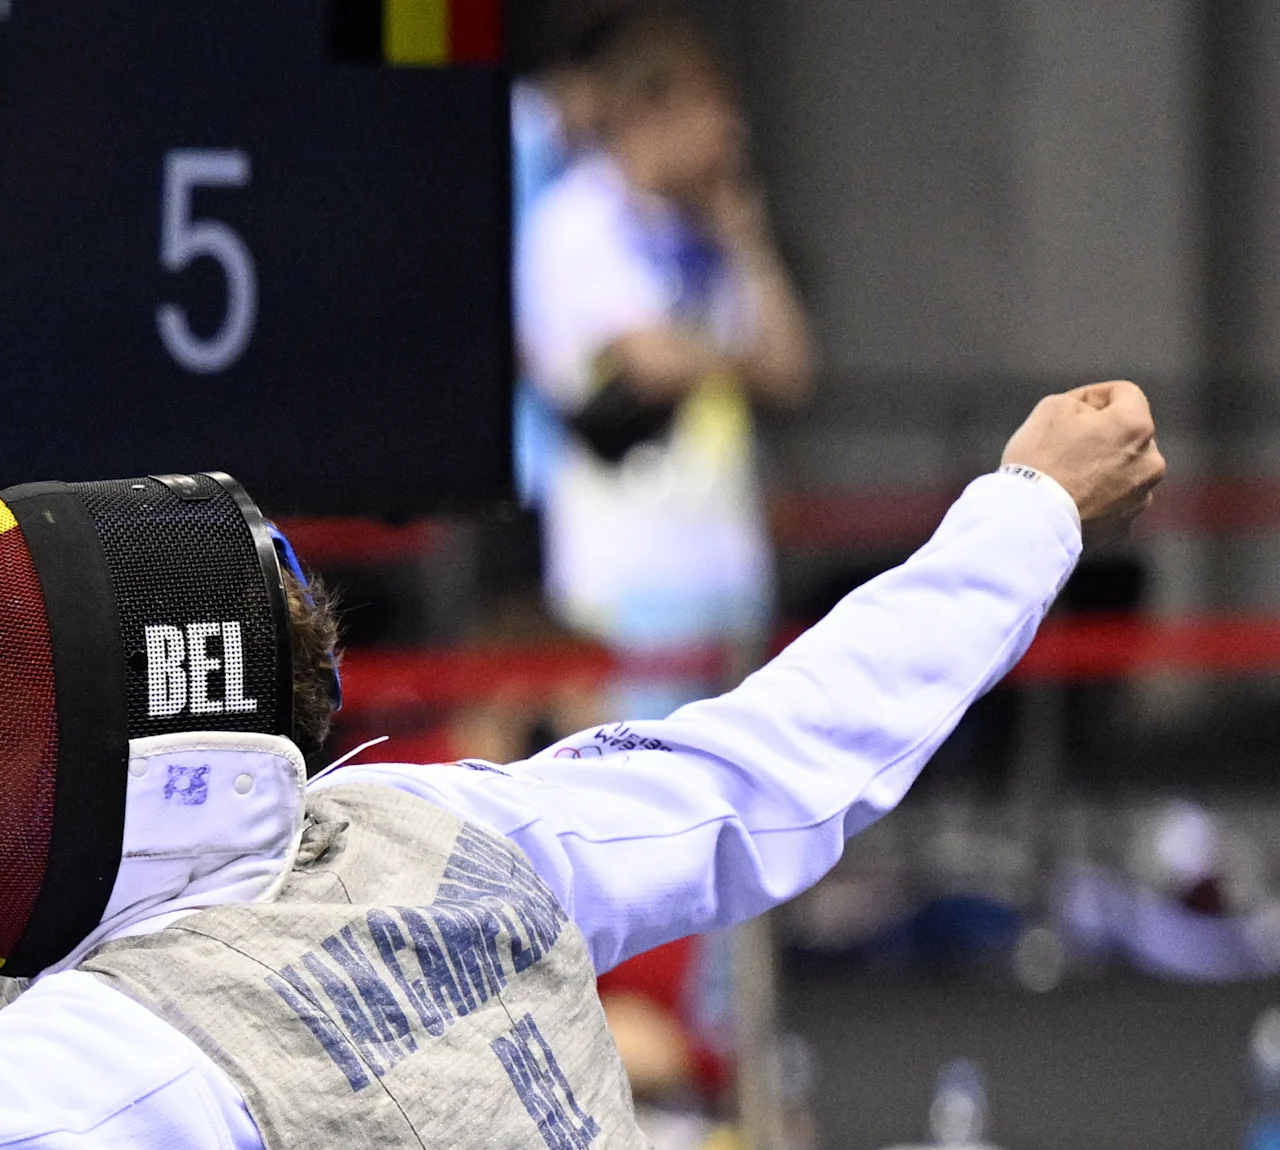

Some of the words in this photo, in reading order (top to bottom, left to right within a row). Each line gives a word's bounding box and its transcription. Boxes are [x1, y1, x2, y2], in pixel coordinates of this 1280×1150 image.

[156, 148, 261, 373] 5
[145, 620, 258, 717] BEL
[264, 924, 419, 1093] VAN
